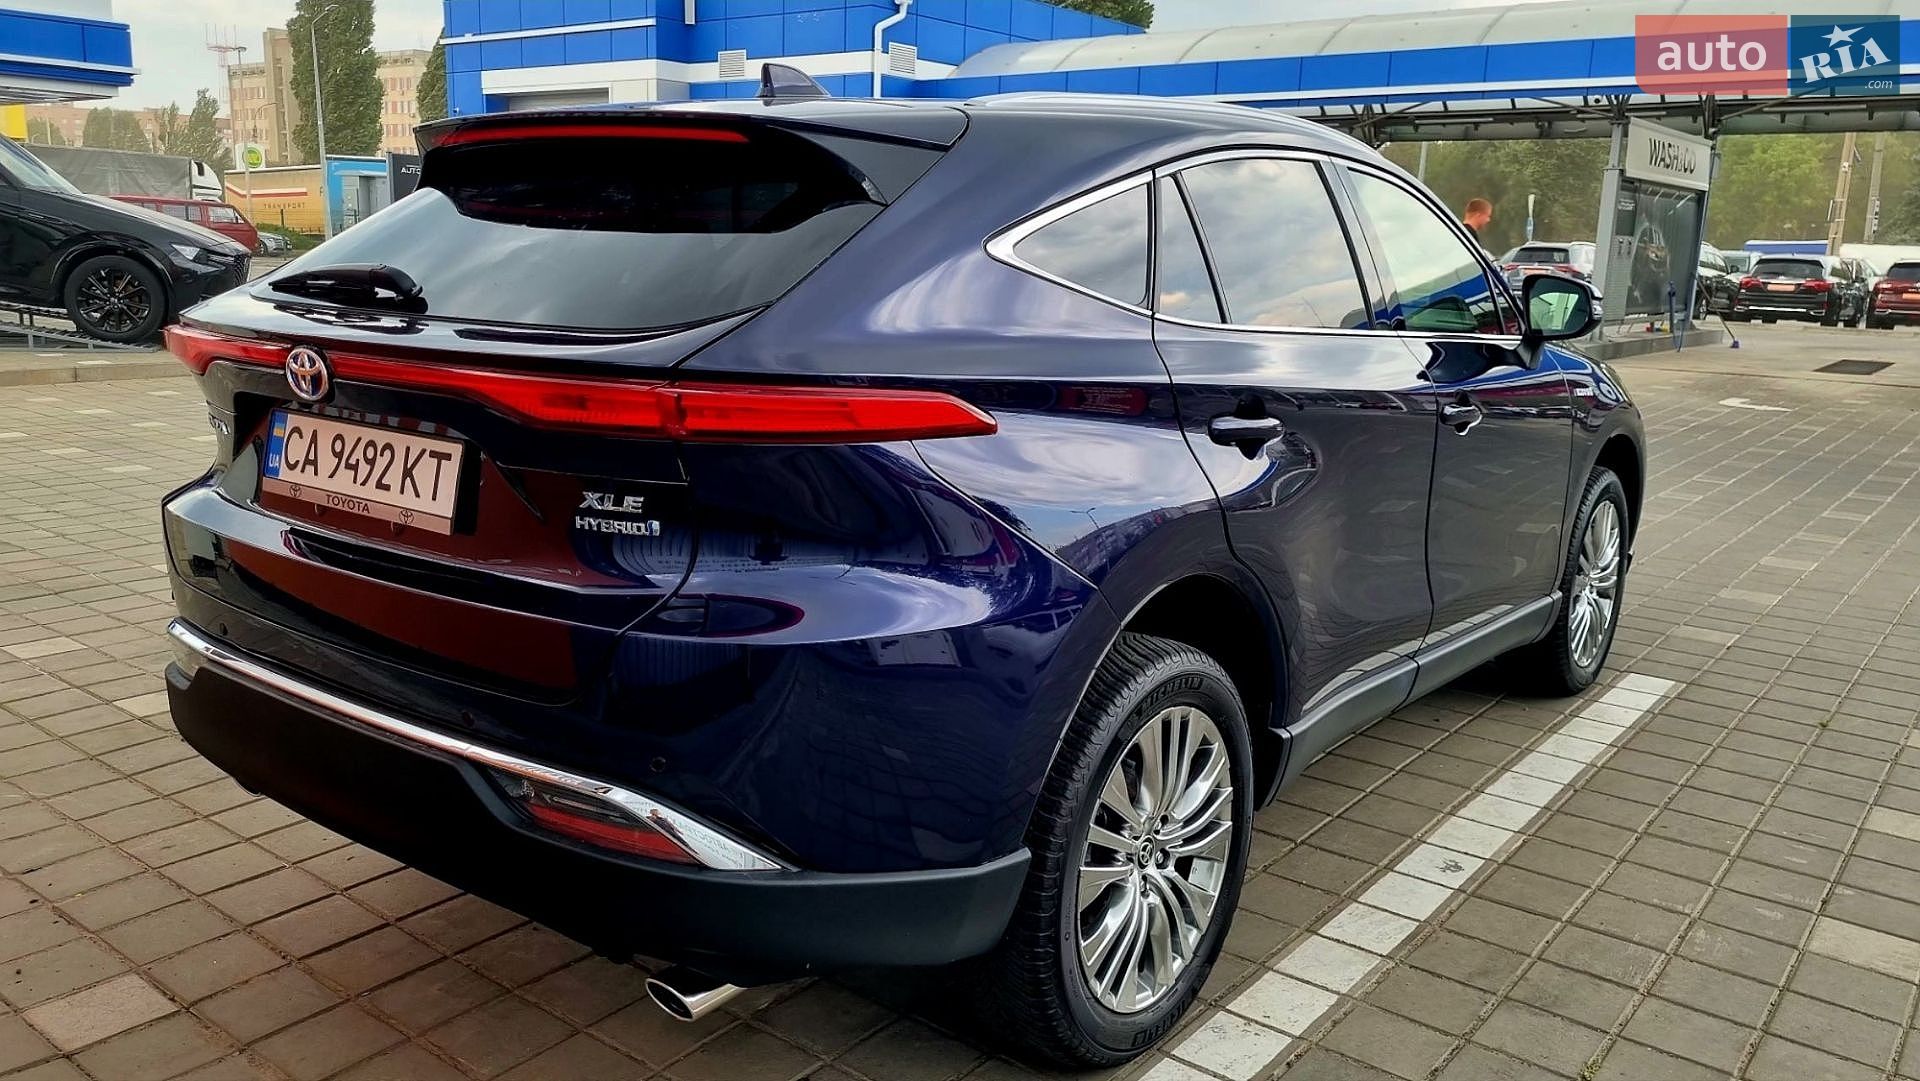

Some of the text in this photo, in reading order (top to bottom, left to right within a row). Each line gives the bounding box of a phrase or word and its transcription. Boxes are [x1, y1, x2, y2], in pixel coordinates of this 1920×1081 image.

[268, 454, 280, 468] UA
[284, 426, 452, 501] CA 9492 KT
[325, 494, 370, 514] TOYOTA
[579, 491, 645, 514] XLE
[575, 515, 646, 536] HYBRID
